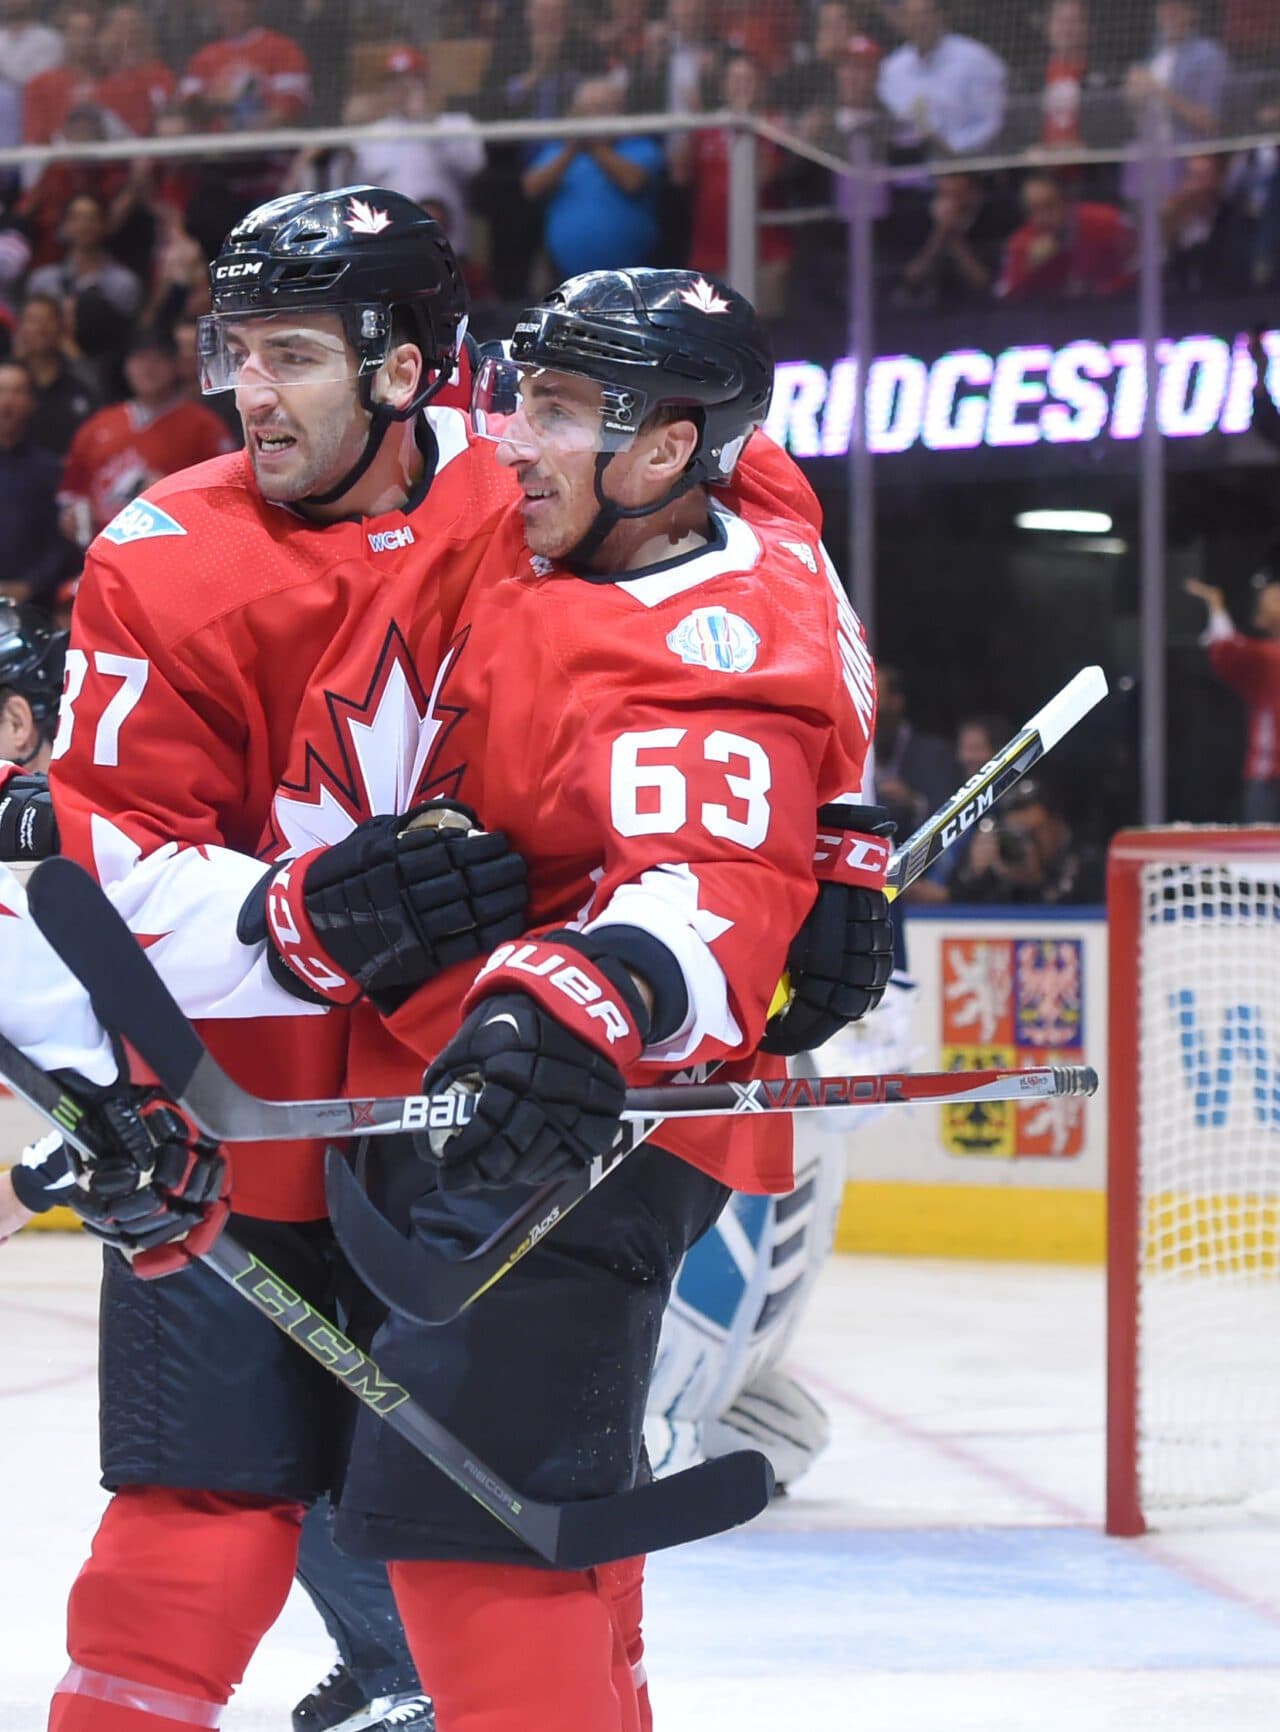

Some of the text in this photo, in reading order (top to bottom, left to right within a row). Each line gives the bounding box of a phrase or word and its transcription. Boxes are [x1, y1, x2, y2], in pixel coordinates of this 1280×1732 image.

[216, 262, 263, 279] CCM
[368, 526, 415, 553] WCH
[610, 727, 772, 850] 63
[940, 783, 993, 849] CCM
[233, 1252, 411, 1414] CCM
